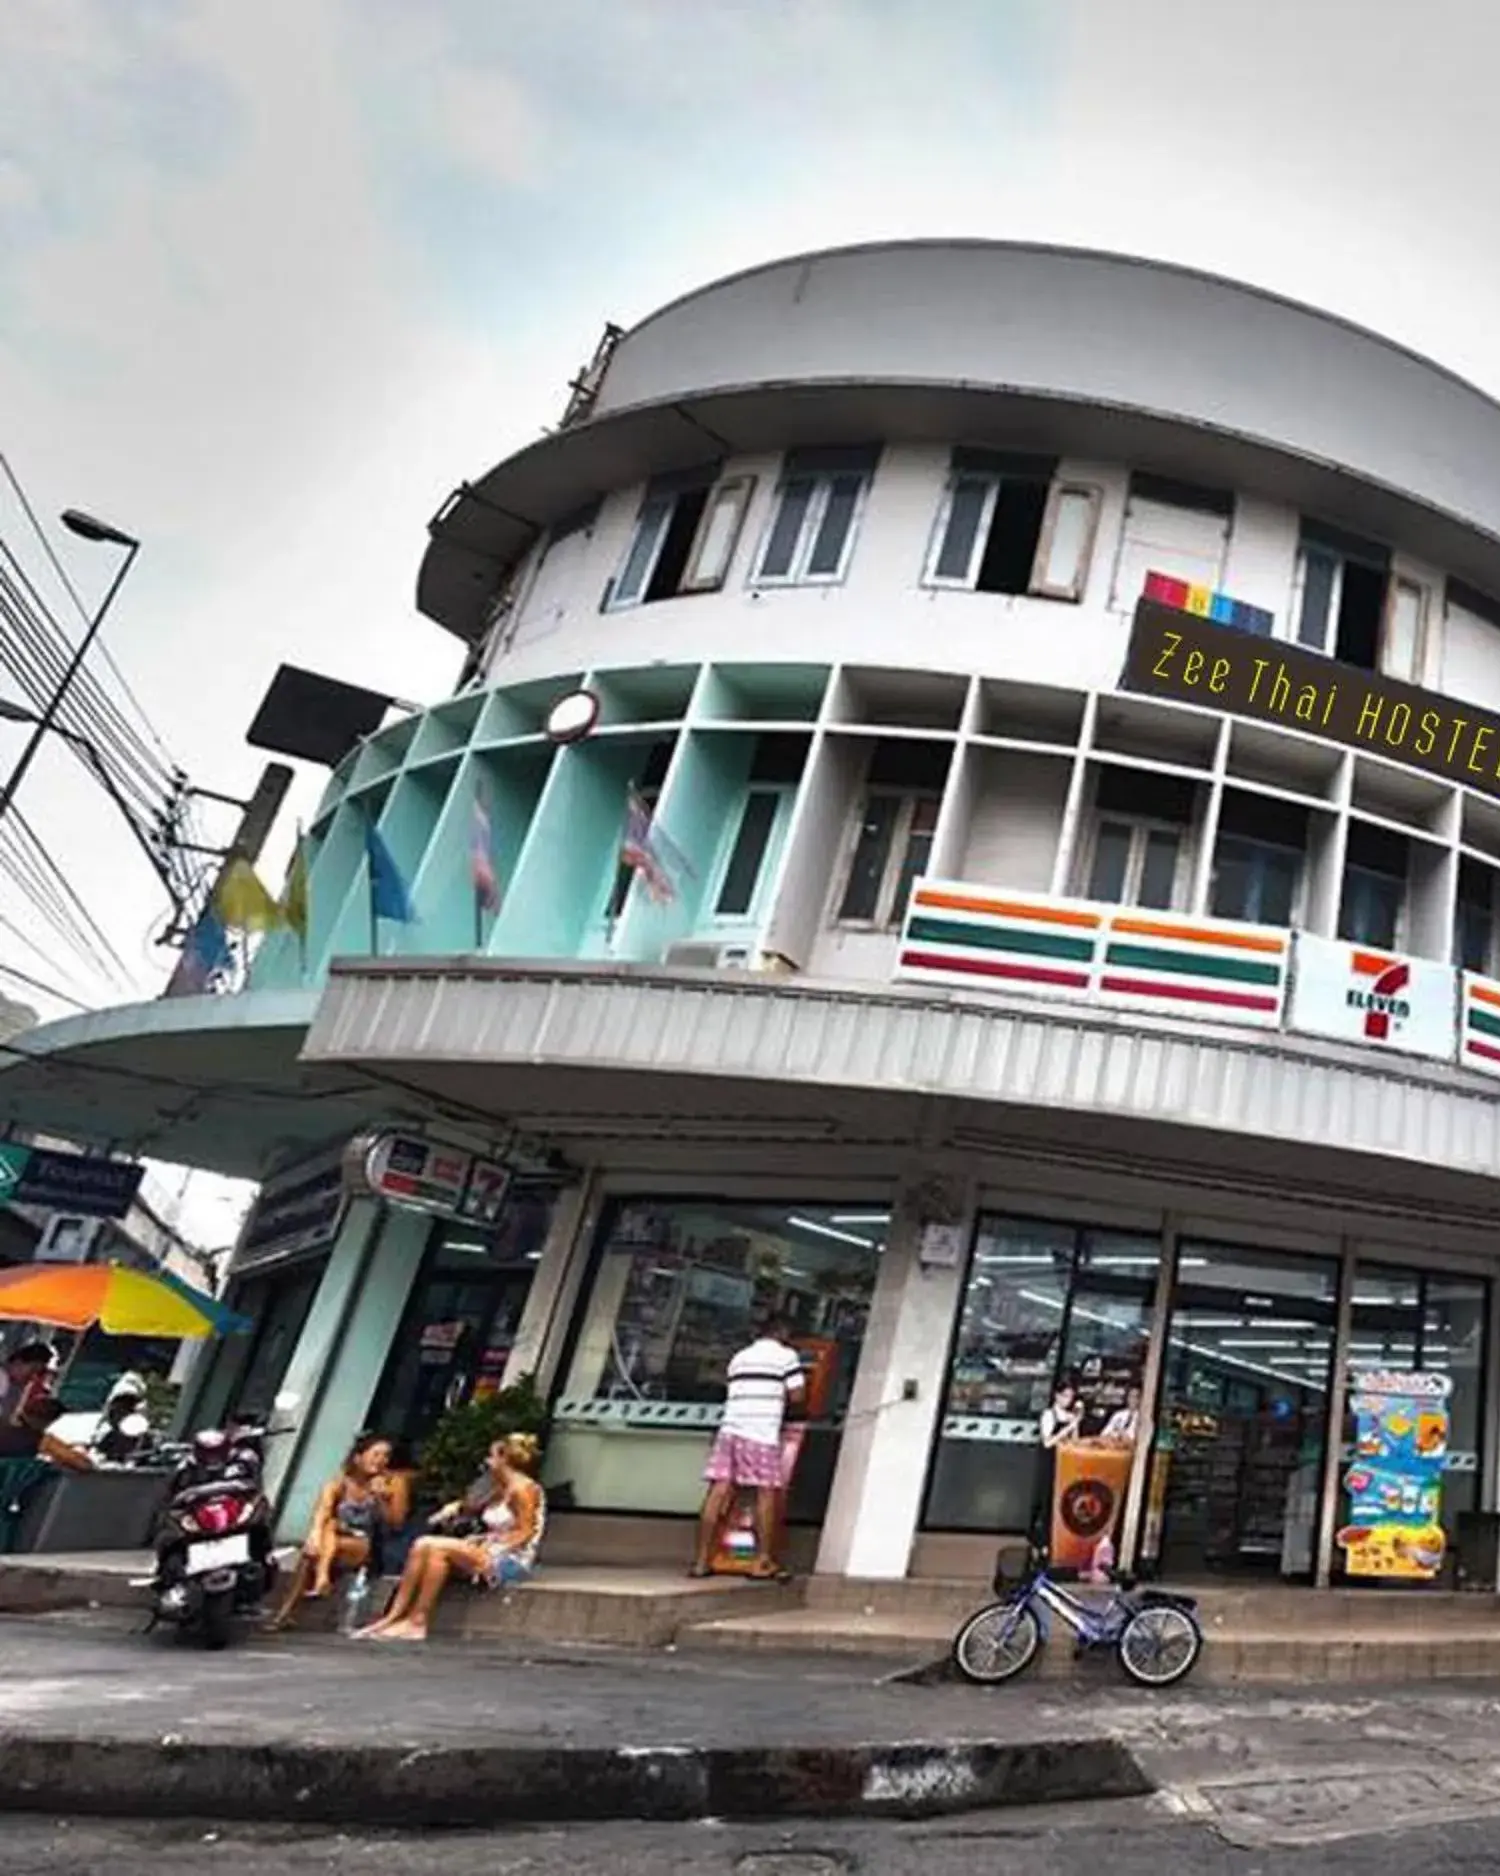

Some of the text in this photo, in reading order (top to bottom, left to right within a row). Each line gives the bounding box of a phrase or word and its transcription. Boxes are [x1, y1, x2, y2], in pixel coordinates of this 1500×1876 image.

[1152, 630, 1230, 692] Zee
[1249, 660, 1335, 725] Thai
[1352, 951, 1409, 1039] 7
